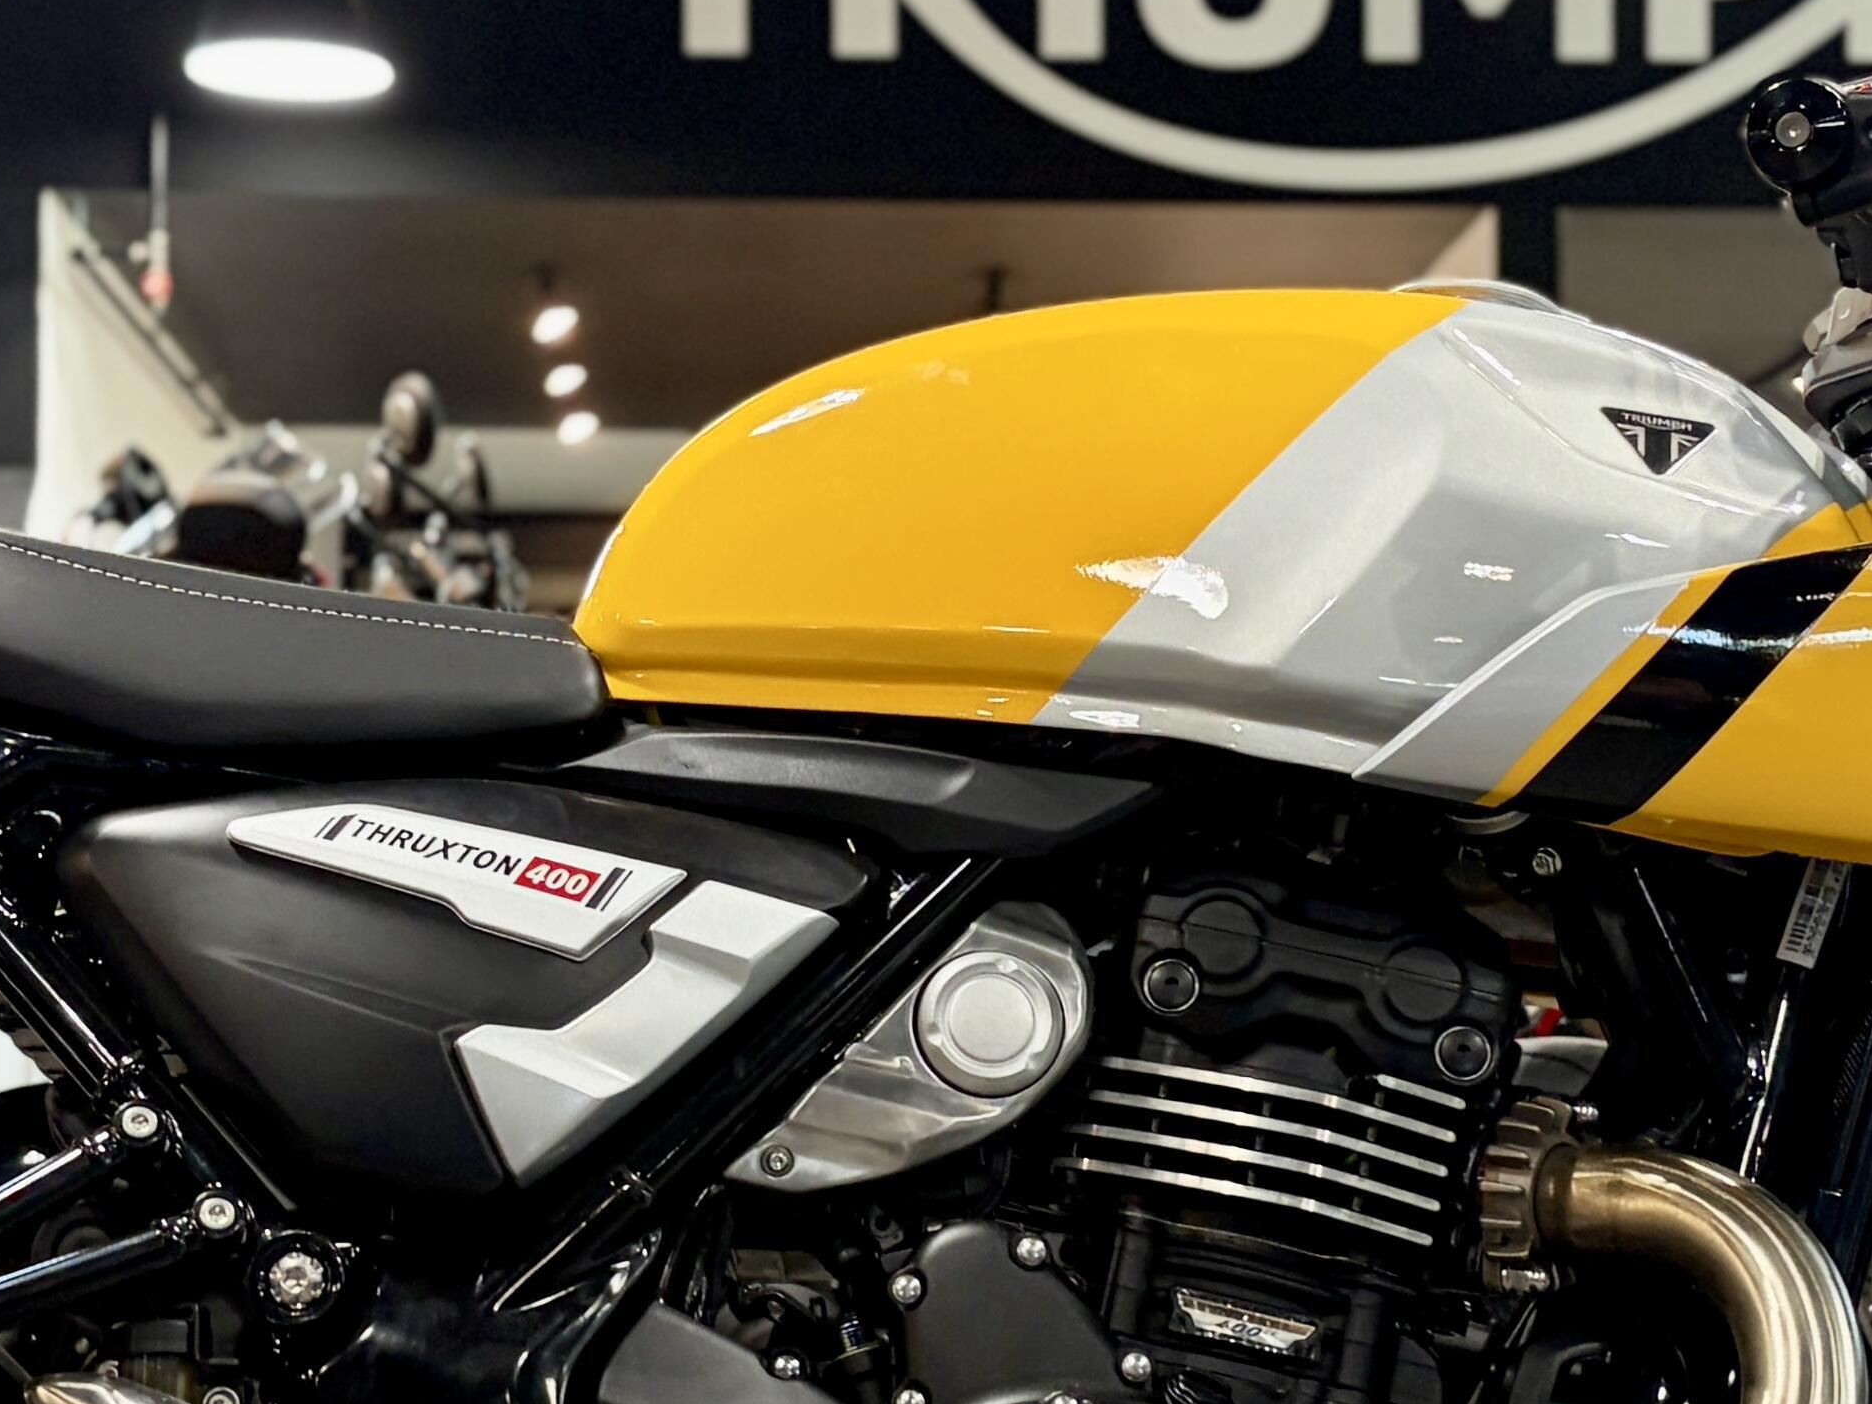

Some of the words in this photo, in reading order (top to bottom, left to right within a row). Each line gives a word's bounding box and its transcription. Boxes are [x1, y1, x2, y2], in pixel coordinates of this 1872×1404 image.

[1621, 412, 1693, 432] TRIUMPH
[351, 819, 522, 877] THRUXTON
[524, 863, 590, 896] 400
